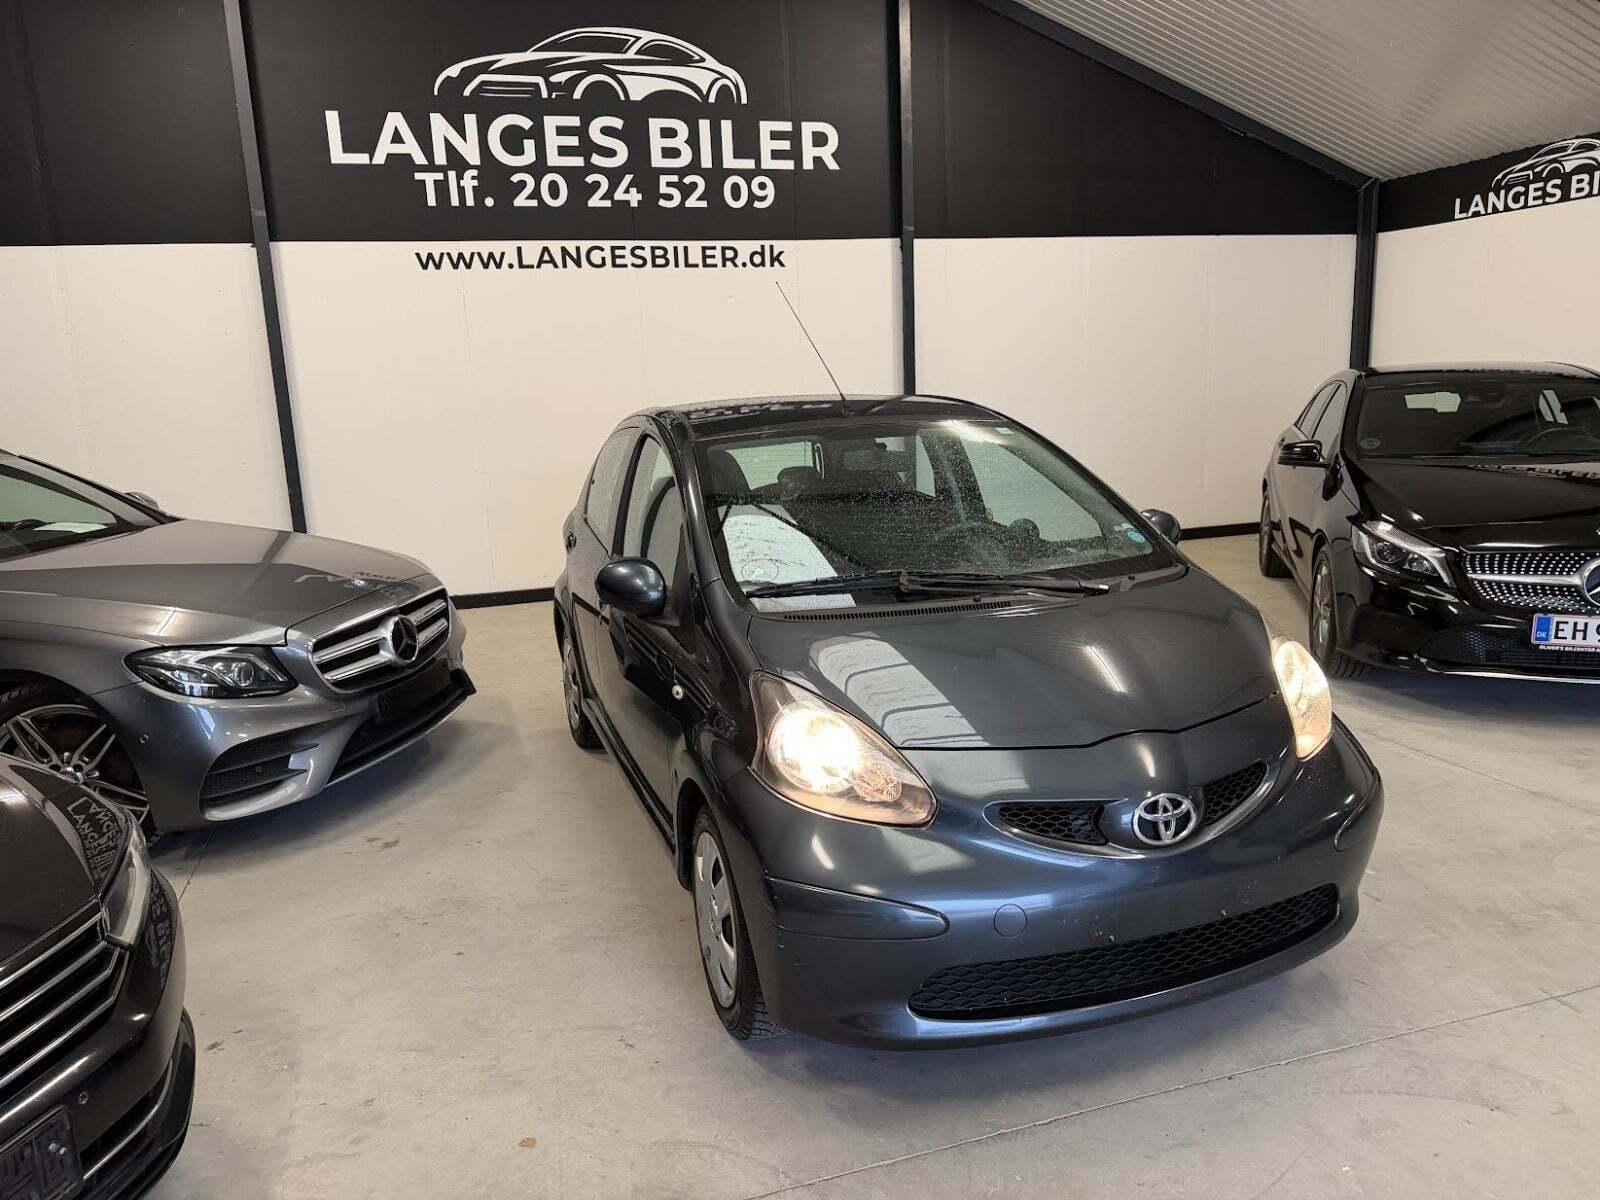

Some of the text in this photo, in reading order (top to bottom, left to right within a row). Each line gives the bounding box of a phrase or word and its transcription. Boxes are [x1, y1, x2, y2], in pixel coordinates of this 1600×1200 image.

[324, 110, 841, 170] LANGES BILER
[413, 169, 776, 209] Tlf. 20 24 52 09
[1454, 178, 1562, 220] LANGES
[414, 244, 786, 271] www.LANGESBILER.dk
[1554, 621, 1588, 640] EH
